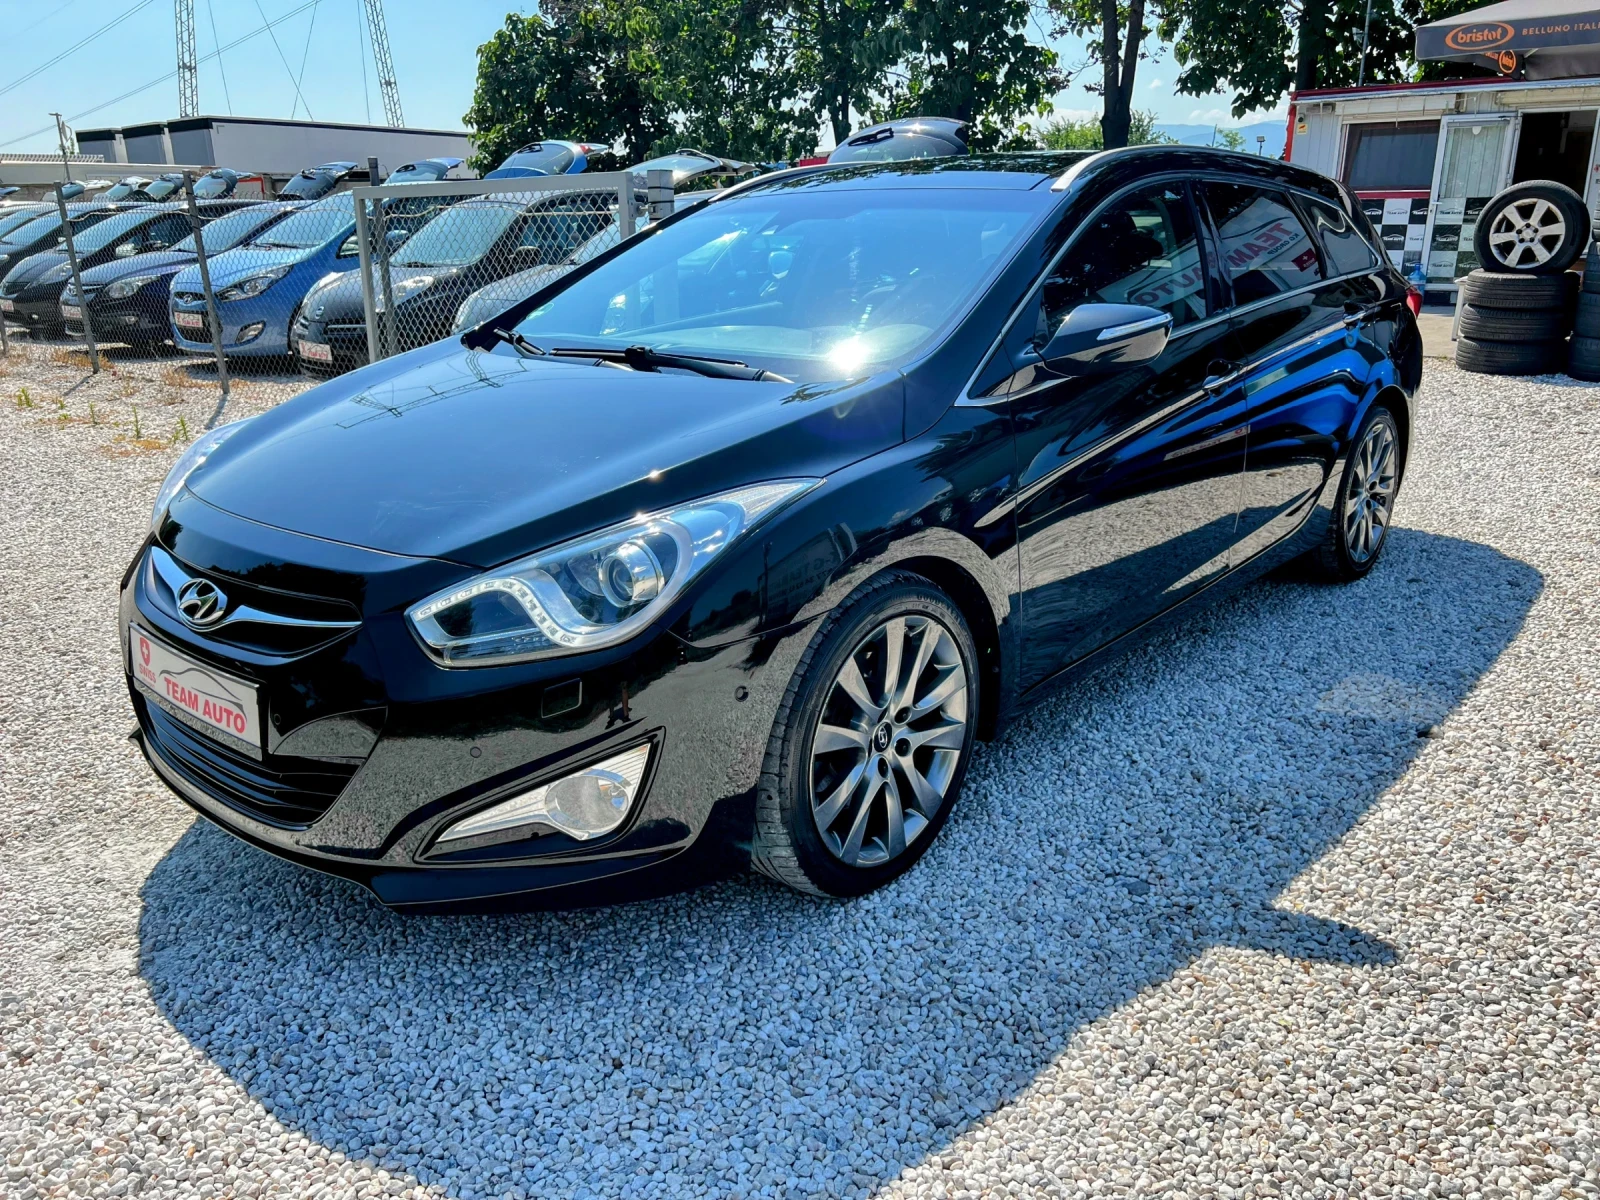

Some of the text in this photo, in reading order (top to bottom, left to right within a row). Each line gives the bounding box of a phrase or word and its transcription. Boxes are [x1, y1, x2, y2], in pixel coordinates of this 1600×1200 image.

[1522, 24, 1571, 36] BELLUNO
[138, 662, 156, 684] SWISS
[164, 676, 246, 734] TEAM AUTO
